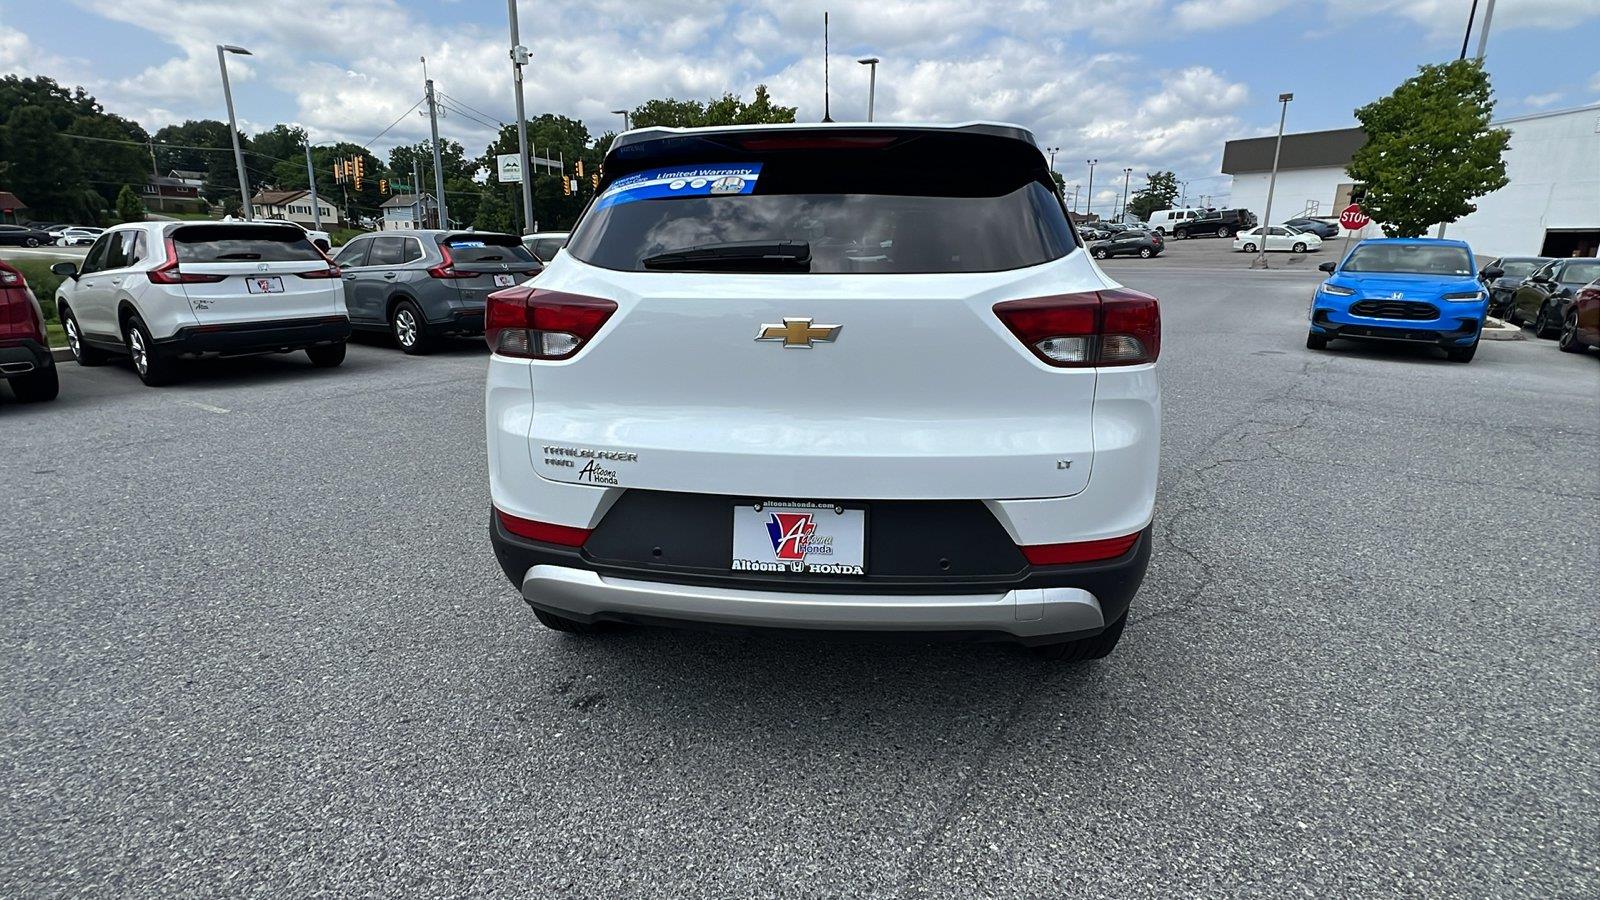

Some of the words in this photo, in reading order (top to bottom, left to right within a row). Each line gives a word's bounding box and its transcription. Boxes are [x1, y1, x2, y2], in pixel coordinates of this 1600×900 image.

[657, 169, 698, 179] Limited
[699, 168, 752, 176] Warranty
[543, 446, 638, 462] TRAILBLAZER
[544, 458, 574, 467] AWD
[1056, 460, 1073, 470] LT
[579, 460, 616, 481] Altoona
[595, 475, 618, 485] Honda
[763, 500, 834, 509] altoonahonda.com
[776, 517, 833, 554] Altoona
[799, 544, 834, 555] Honda
[732, 560, 786, 572] Altoona
[809, 563, 864, 575] HONDA
